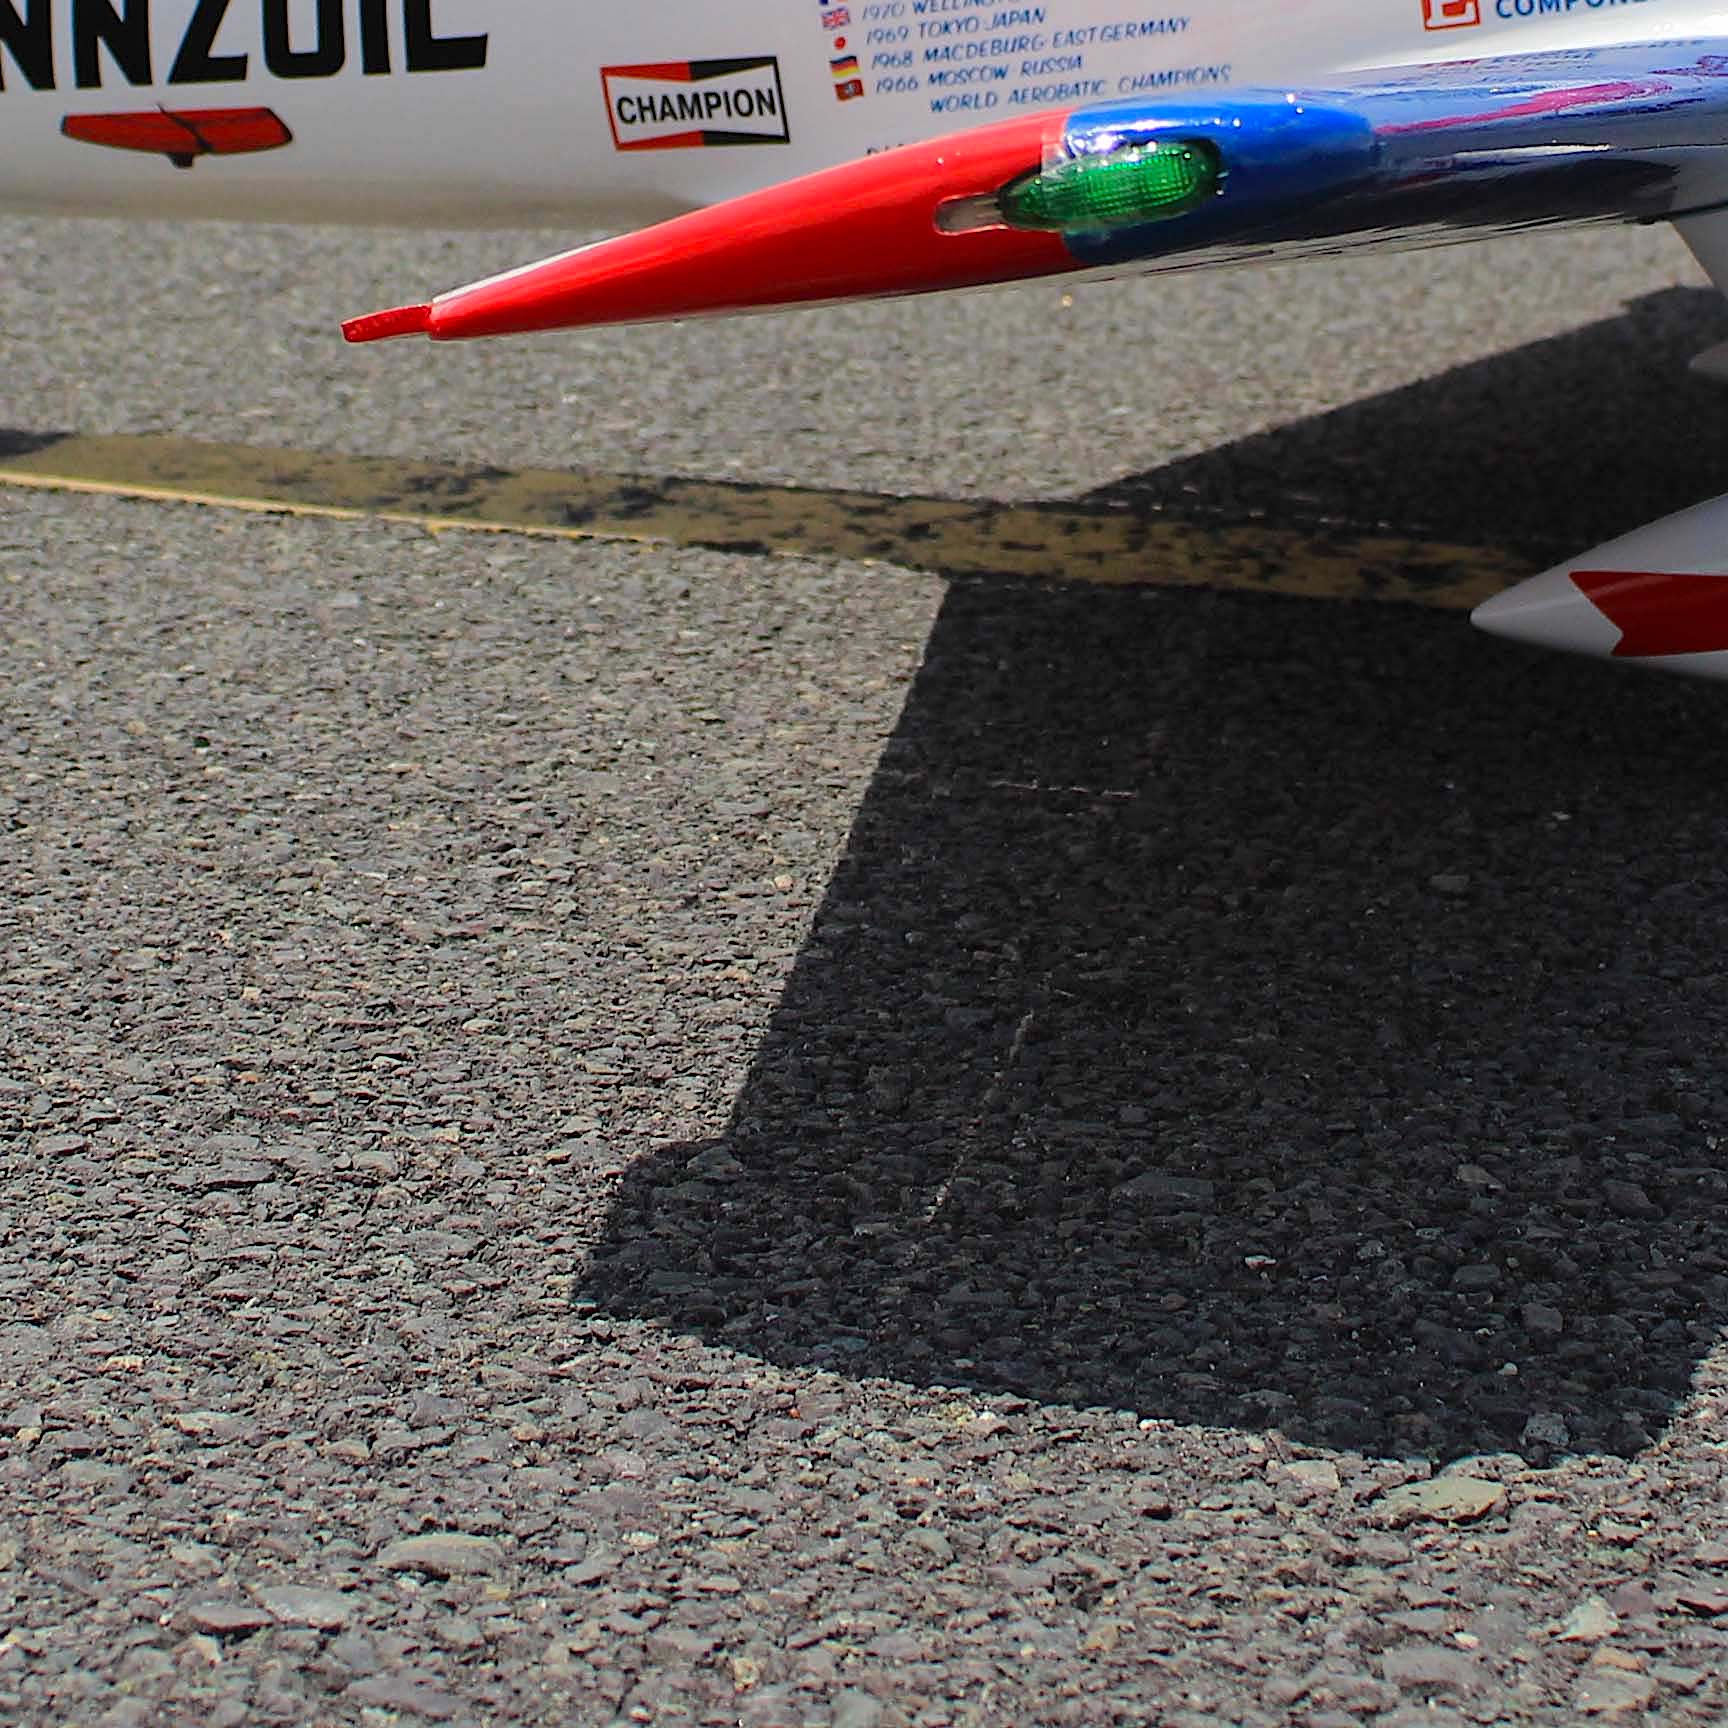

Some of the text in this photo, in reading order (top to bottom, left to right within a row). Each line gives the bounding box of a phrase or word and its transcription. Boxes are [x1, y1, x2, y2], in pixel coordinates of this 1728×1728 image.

[862, 0, 905, 21] 1970
[867, 7, 1046, 45] 1969 TOKYO JAPAN
[872, 51, 913, 71] 1968
[876, 56, 1083, 94] 1966 MOSCOW RUSSIA
[617, 87, 776, 124] CHAMPION
[930, 64, 1231, 113] WORLD AEROBATIC CHAMPIONS
